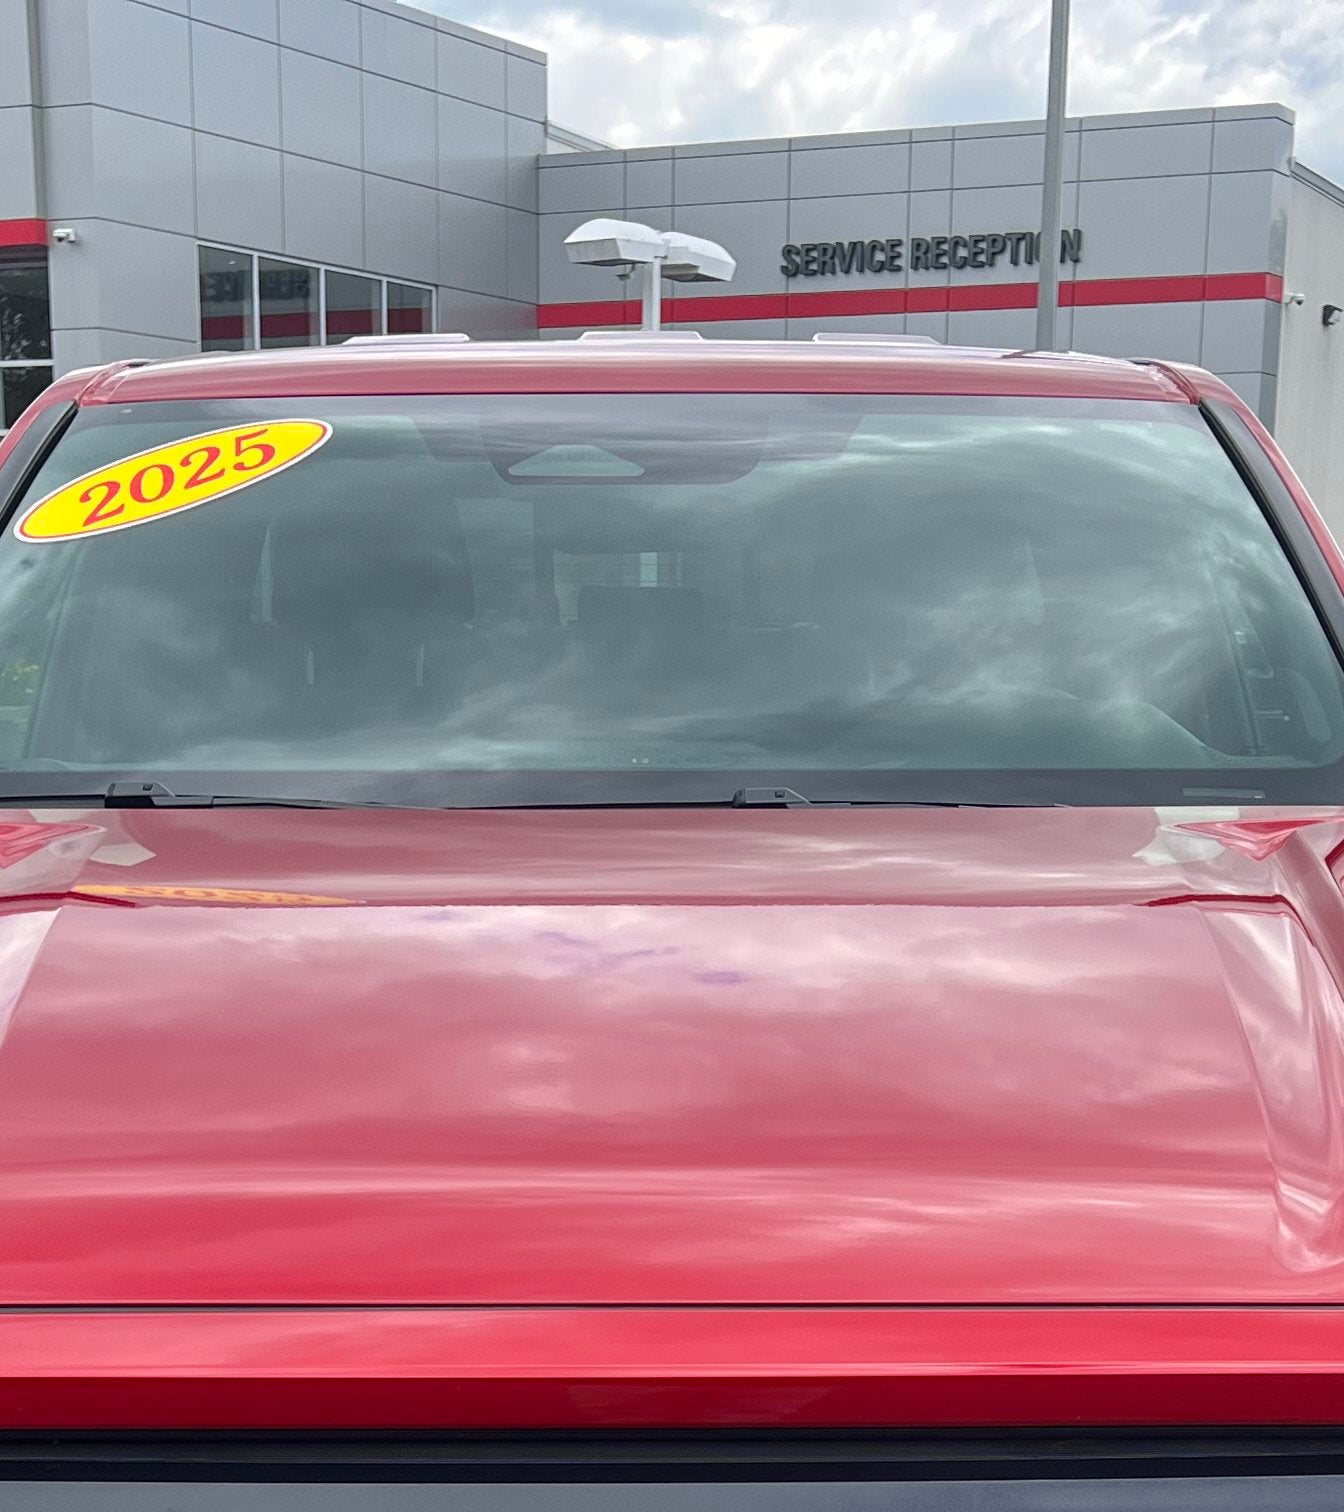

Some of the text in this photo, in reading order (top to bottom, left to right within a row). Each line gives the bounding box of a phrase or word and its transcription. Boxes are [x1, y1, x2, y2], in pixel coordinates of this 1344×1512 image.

[781, 229, 1081, 276] SERVICE RECEPTIN
[79, 428, 276, 527] 2025
